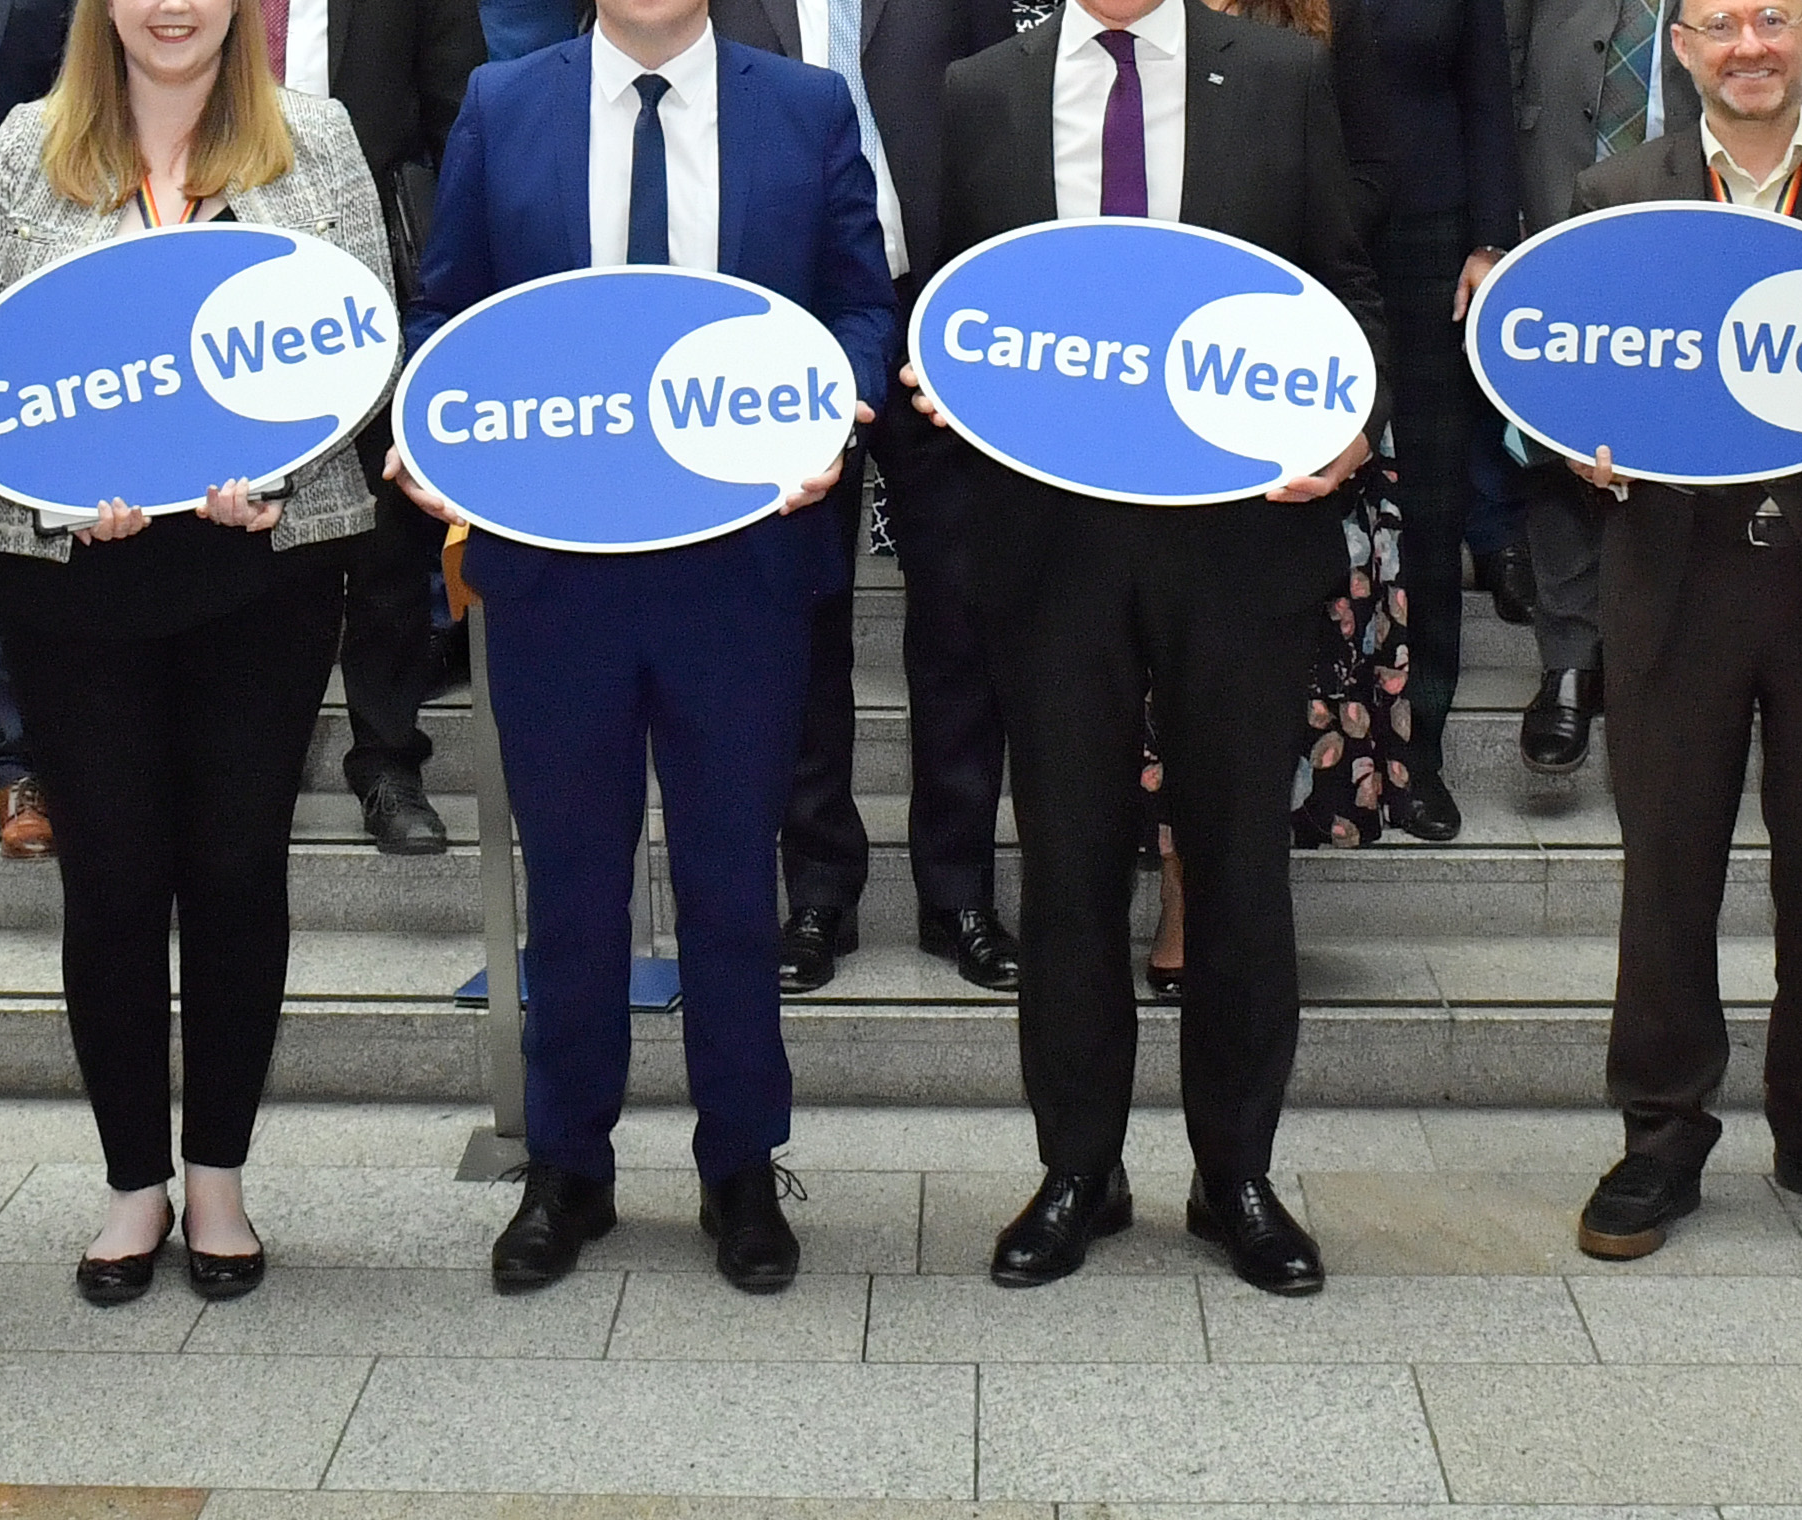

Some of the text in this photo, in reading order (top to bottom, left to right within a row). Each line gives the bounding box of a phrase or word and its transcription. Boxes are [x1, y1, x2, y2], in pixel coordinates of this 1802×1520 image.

[201, 296, 386, 380] Week
[943, 308, 1358, 413] Carers Week
[1501, 307, 1702, 370] Carers
[427, 367, 842, 444] Carers Week
